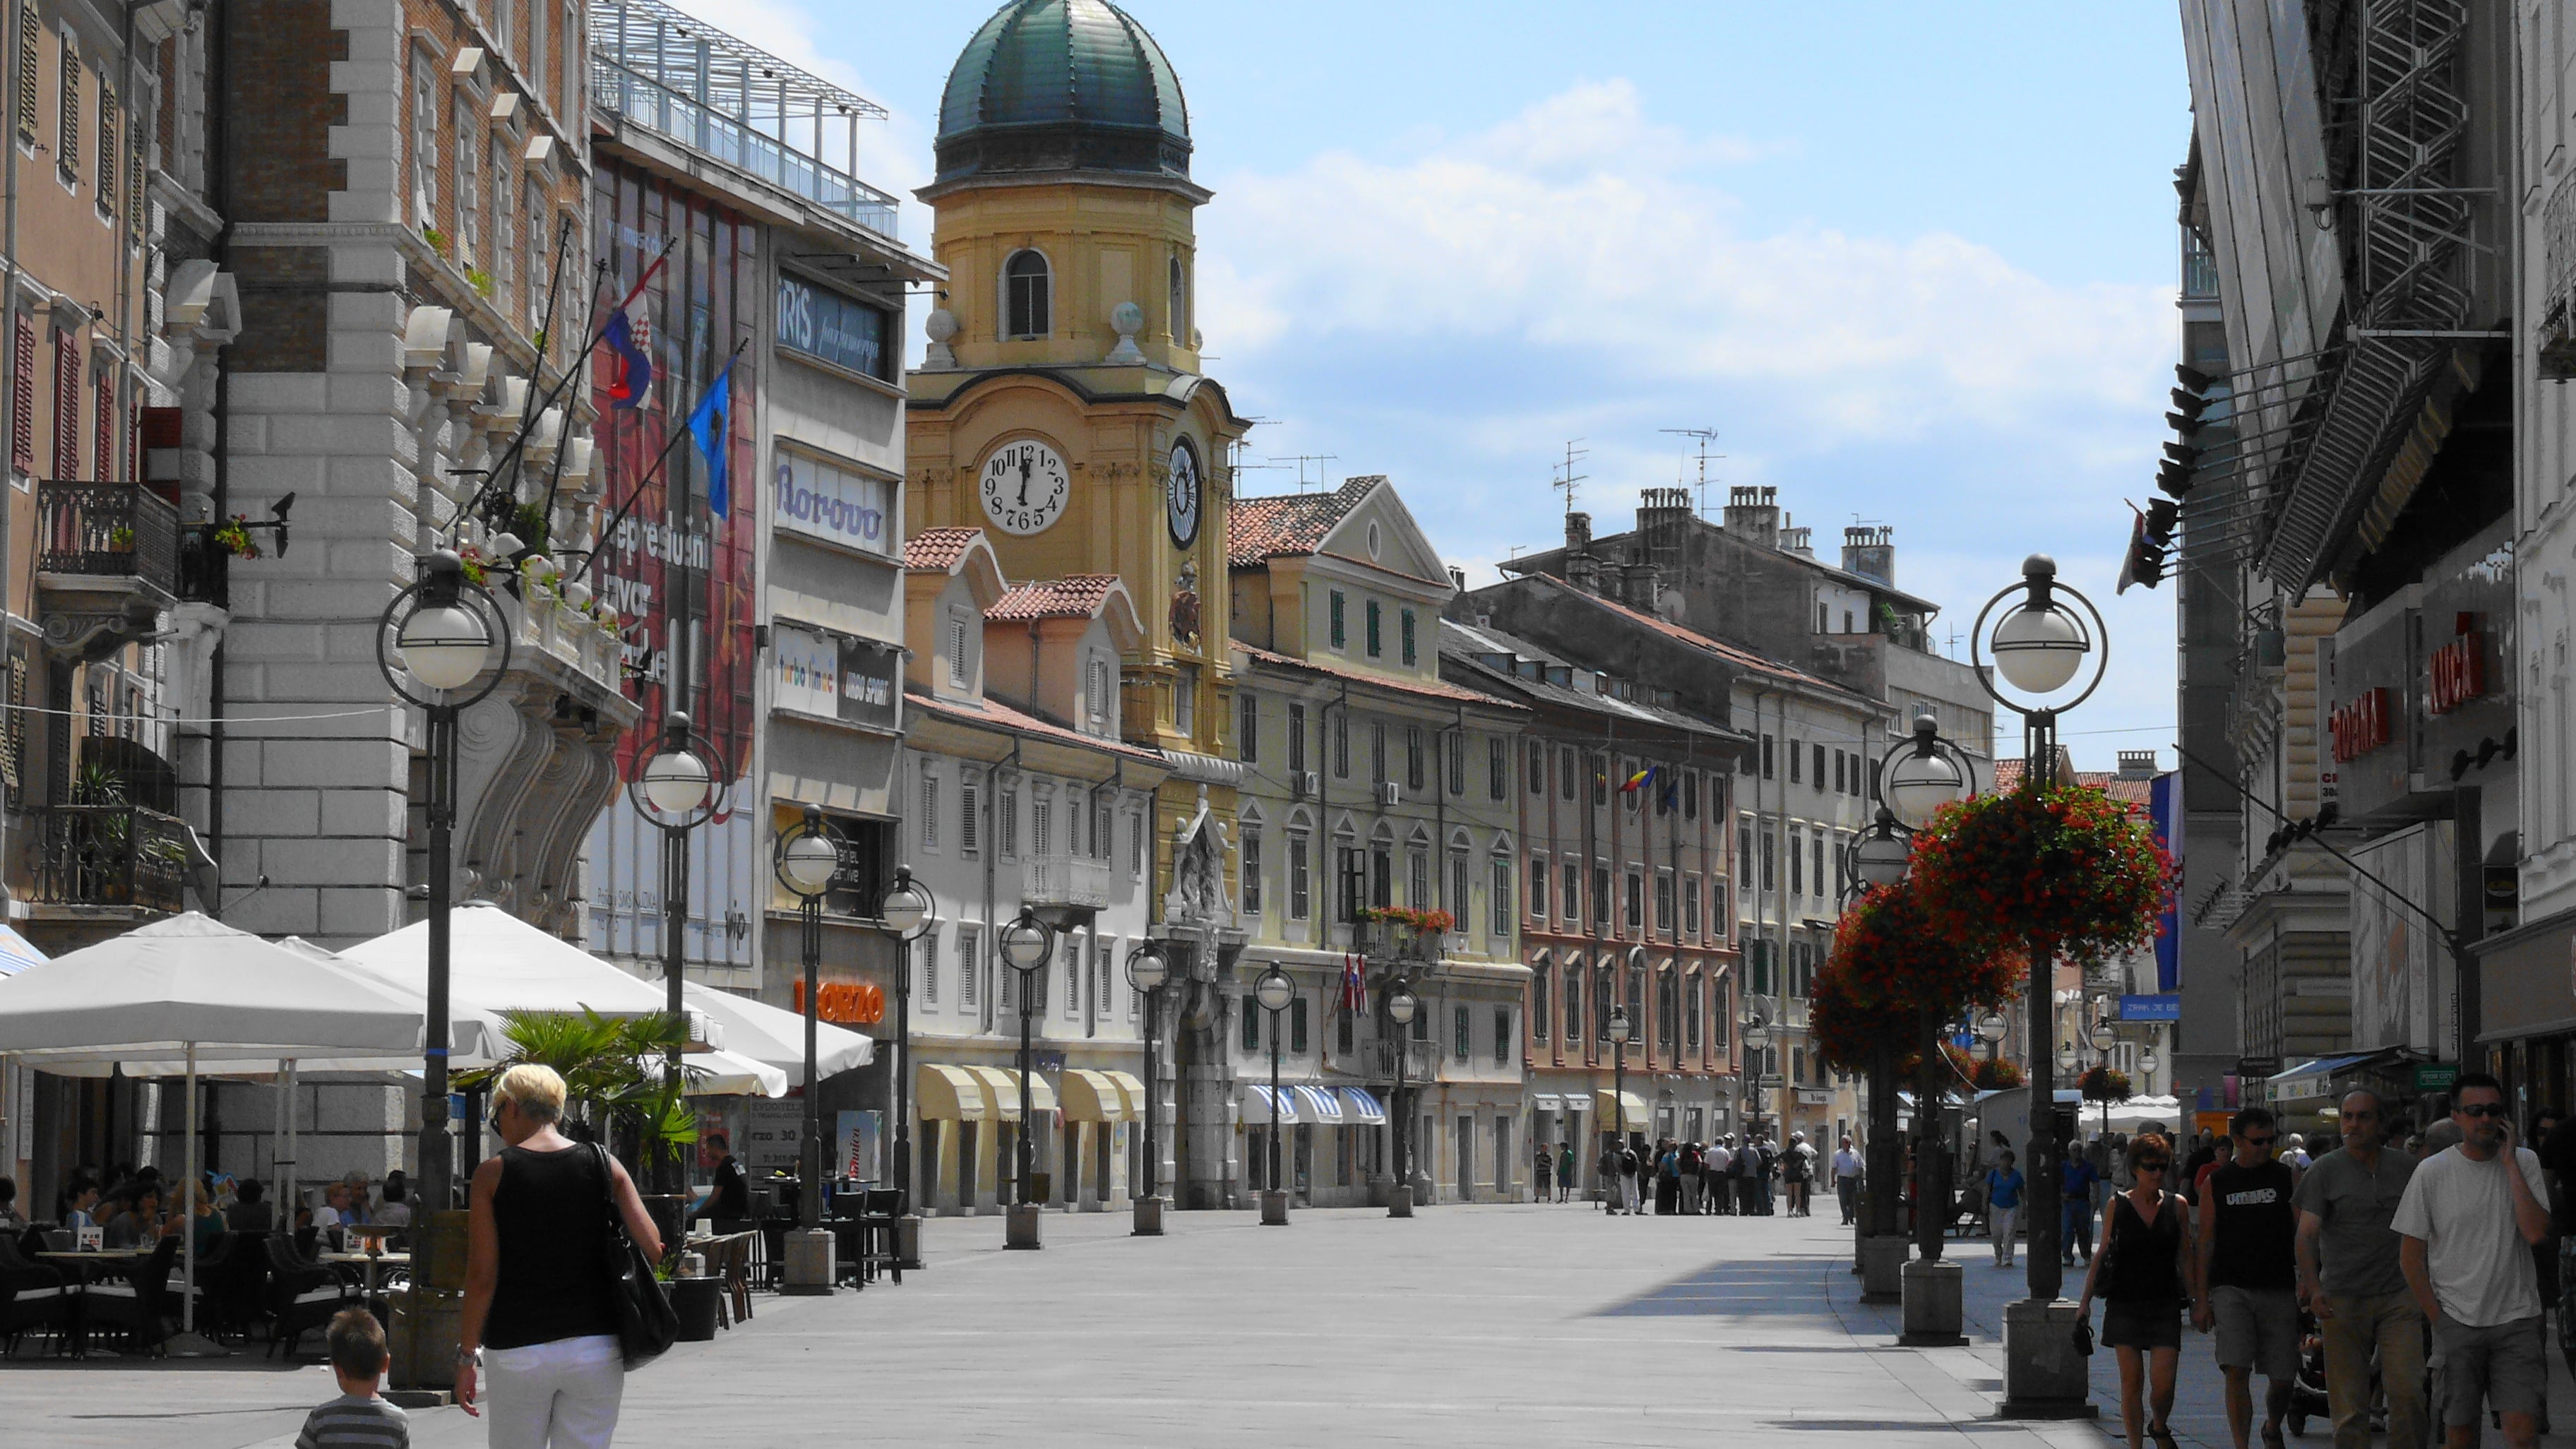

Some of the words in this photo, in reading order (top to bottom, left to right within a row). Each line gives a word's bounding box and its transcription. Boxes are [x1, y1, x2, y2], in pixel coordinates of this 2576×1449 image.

[1005, 448, 1015, 467] 11
[1039, 449, 1045, 467] 1
[1047, 458, 1056, 476] 2
[991, 458, 1006, 477] 10
[985, 478, 996, 496] 9
[1054, 476, 1064, 494] 3
[991, 496, 1003, 515] 8
[1045, 494, 1057, 512] 4
[1006, 508, 1017, 527] 7
[1018, 511, 1030, 530] 6
[1033, 506, 1045, 527] 5
[779, 654, 806, 688] turbo
[724, 899, 746, 951] vip
